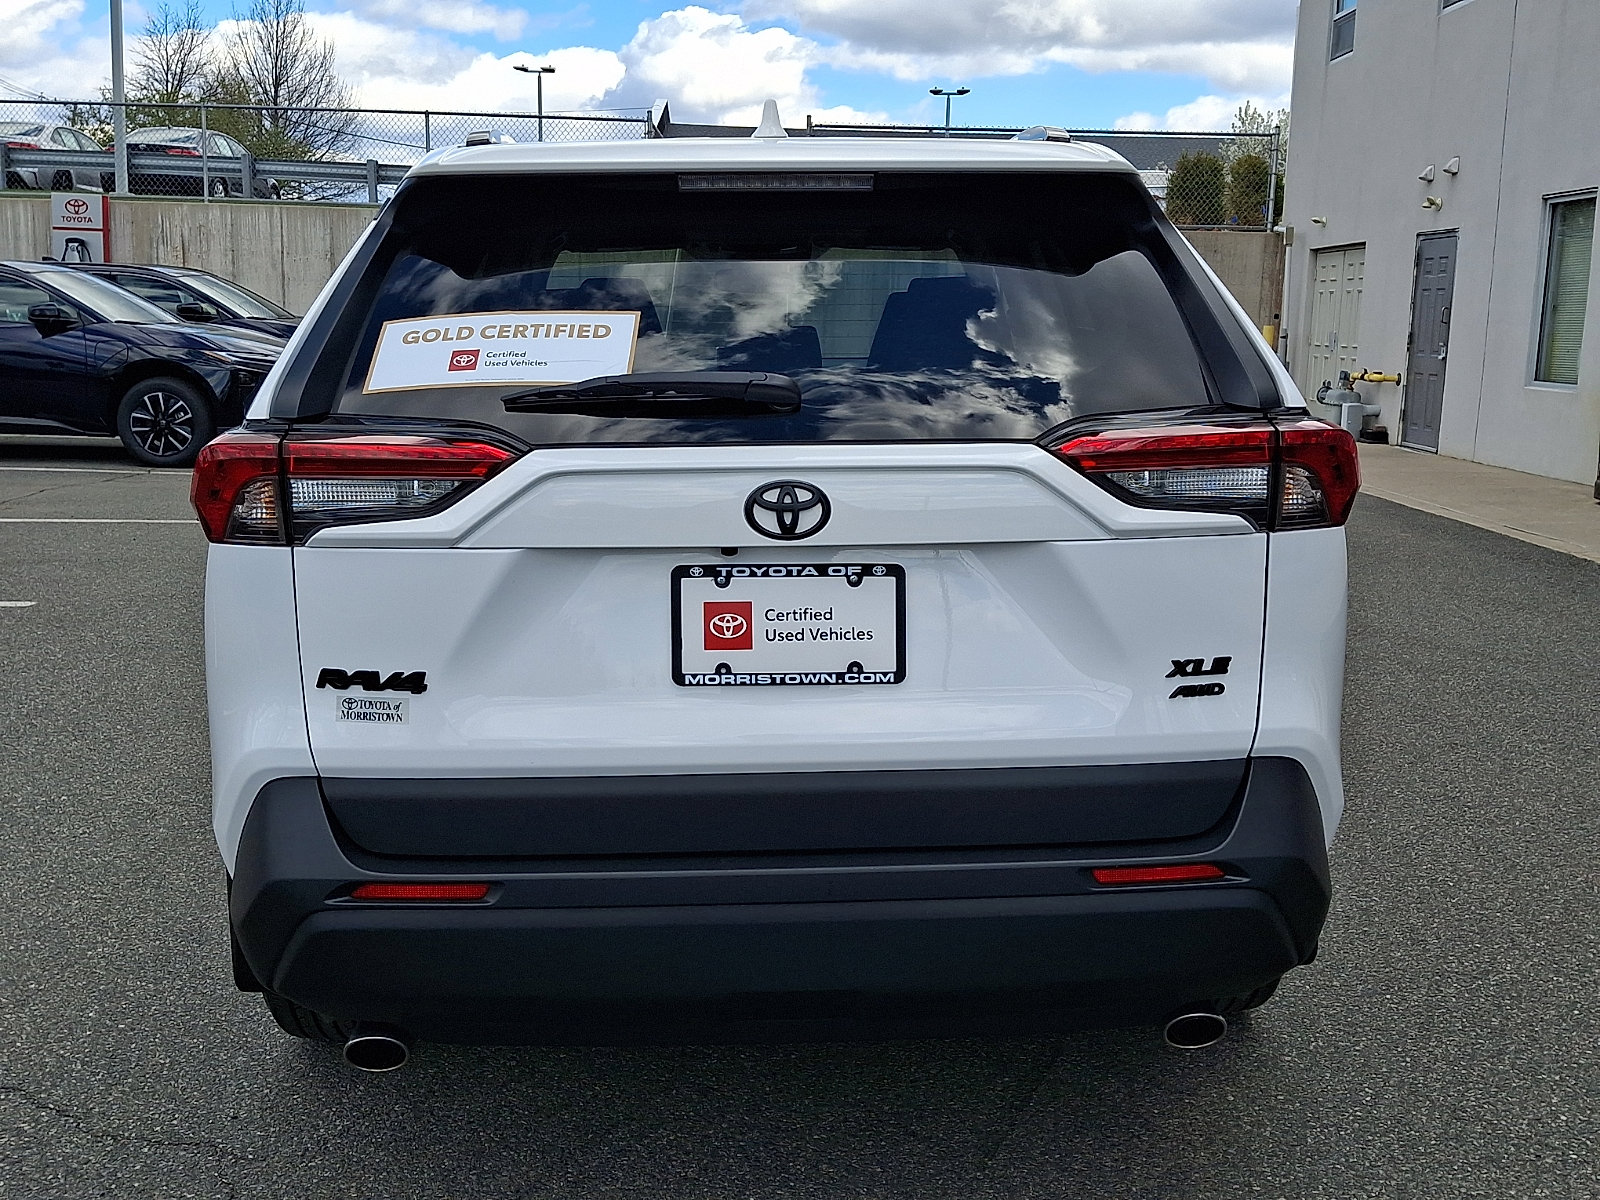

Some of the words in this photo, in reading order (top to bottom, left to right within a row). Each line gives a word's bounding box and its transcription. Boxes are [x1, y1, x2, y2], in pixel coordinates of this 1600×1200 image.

[61, 215, 93, 223] TOYOTA
[402, 326, 475, 345] GOLD
[480, 324, 612, 340] CERTIFIED
[716, 566, 819, 577] TOYOTA
[828, 566, 862, 577] OF
[764, 607, 833, 622] Certified
[765, 628, 805, 642] Used
[809, 627, 874, 641] Vehicles
[1165, 656, 1232, 678] XLE
[316, 668, 428, 694] RAV4
[684, 673, 895, 685] MORRISTOWN.COM
[1168, 682, 1226, 699] AWD
[358, 699, 391, 710] TOYOTA
[393, 702, 403, 712] of
[341, 710, 403, 722] MORRISTOWN
